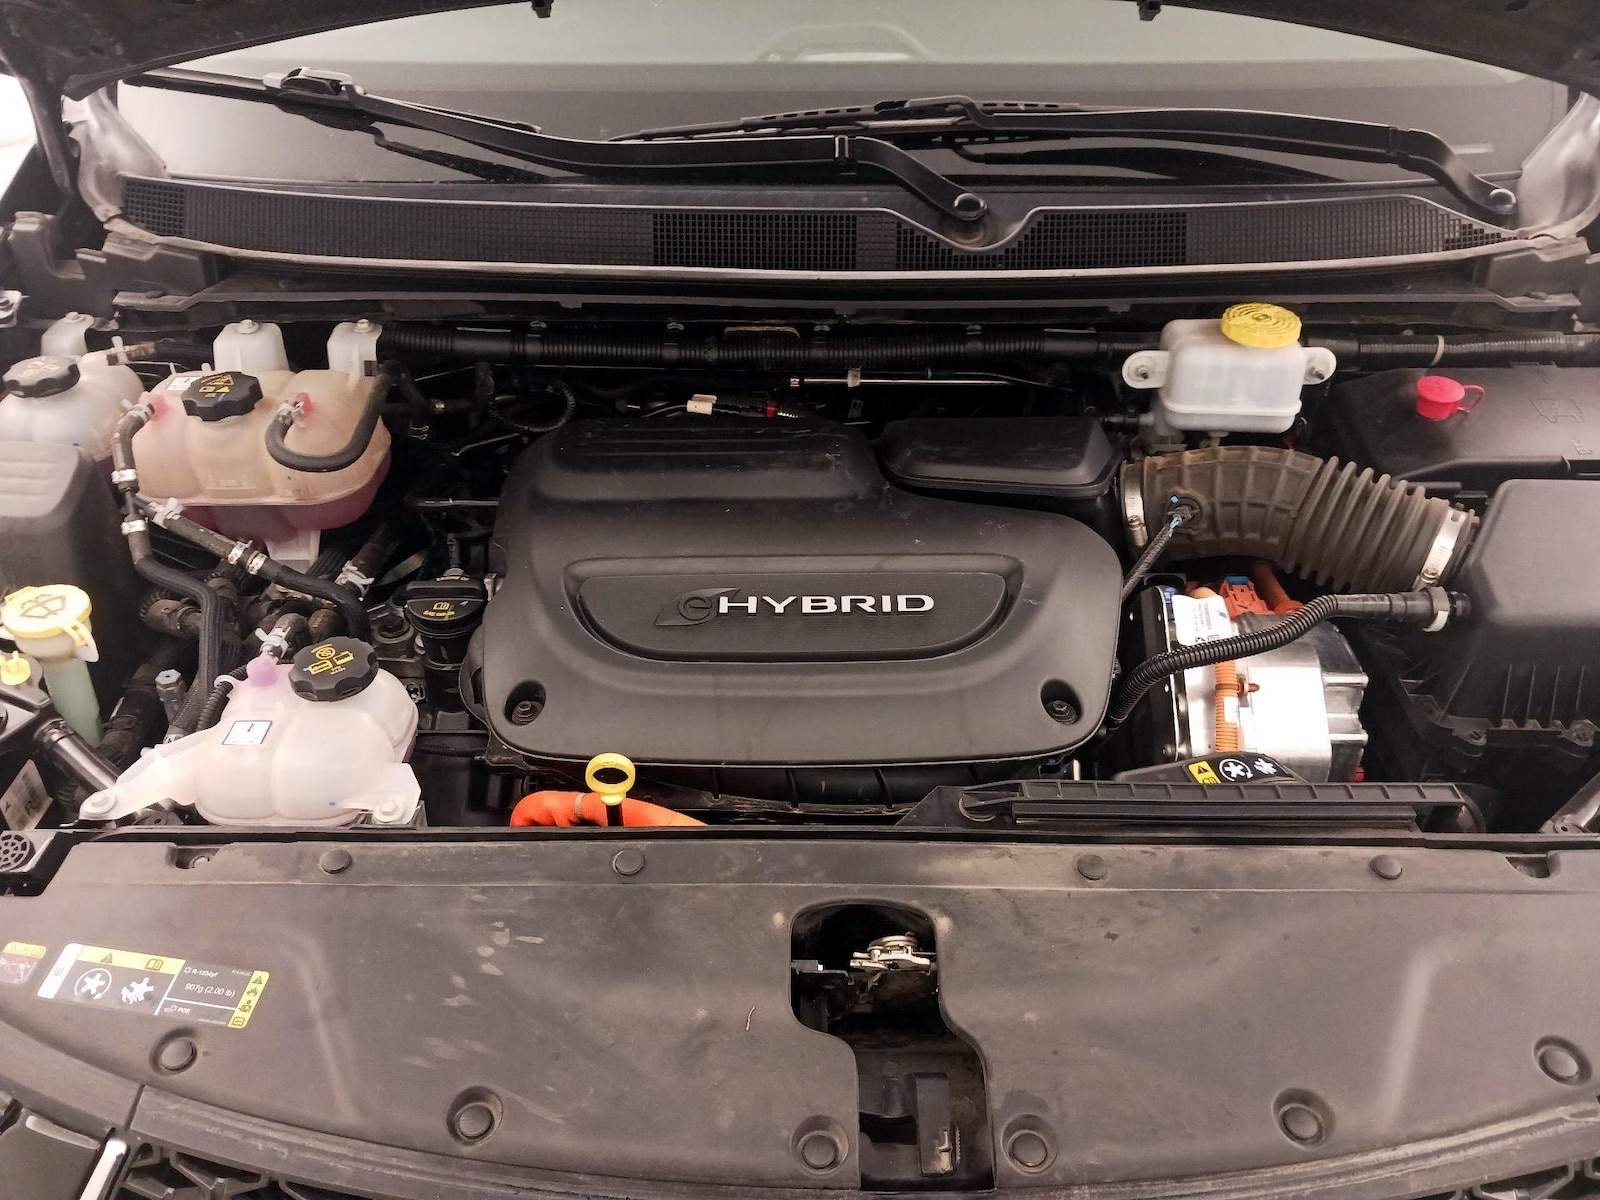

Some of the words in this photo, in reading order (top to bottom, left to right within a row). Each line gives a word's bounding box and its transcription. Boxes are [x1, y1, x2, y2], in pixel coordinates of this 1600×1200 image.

[185, 982, 204, 994] 907g
[204, 985, 225, 995] (2.00
[224, 989, 236, 998] lb)
